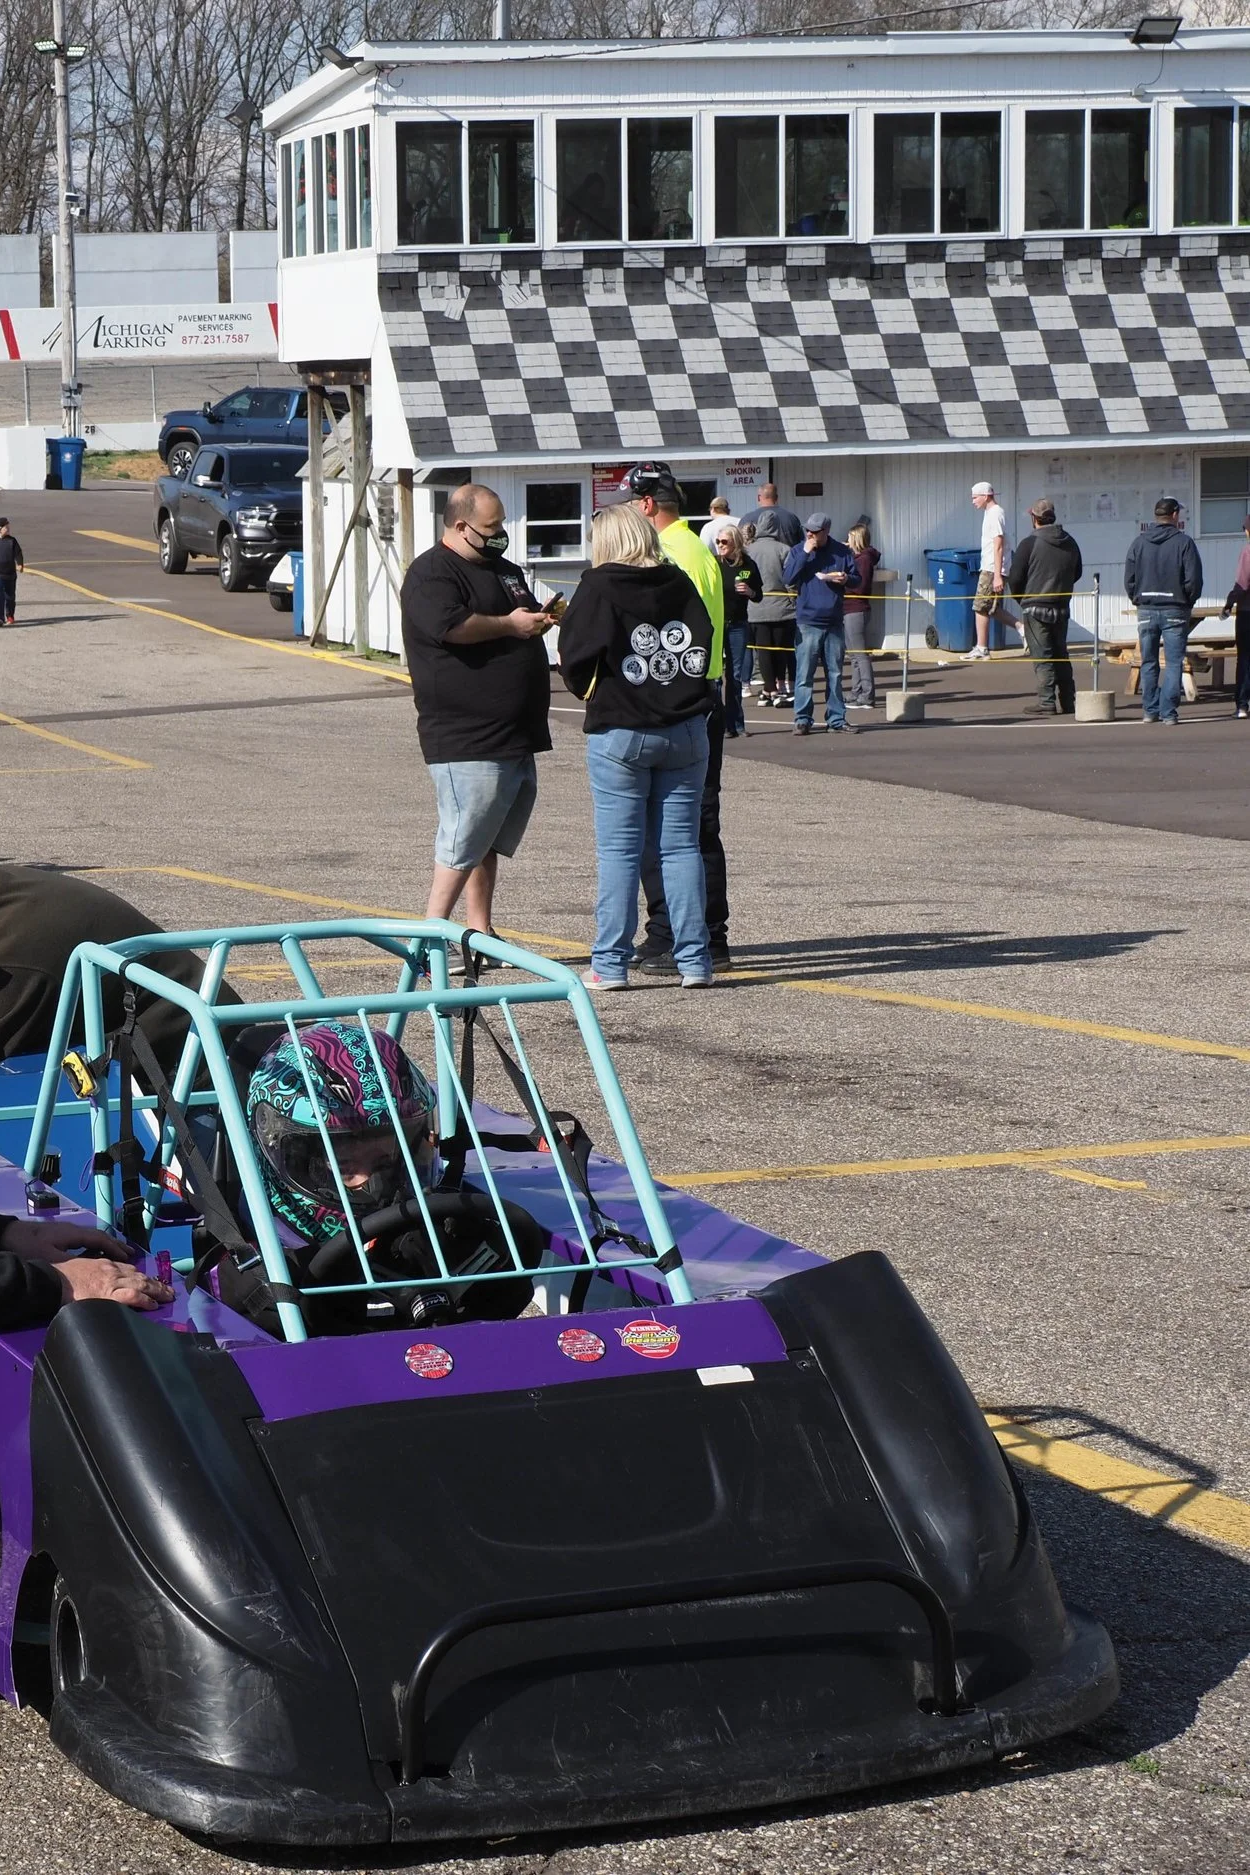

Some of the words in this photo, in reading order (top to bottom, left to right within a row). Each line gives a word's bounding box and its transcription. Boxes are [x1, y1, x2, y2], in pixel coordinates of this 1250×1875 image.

[178, 314, 217, 323] PAVEMENT
[218, 313, 252, 322] MARKING
[198, 323, 234, 332] SERVICES
[181, 334, 250, 345] 877.231.7587
[734, 458, 752, 466] NON
[726, 467, 762, 476] SMOKING
[733, 477, 755, 485] AREA
[625, 1336, 677, 1344] Pleasant
